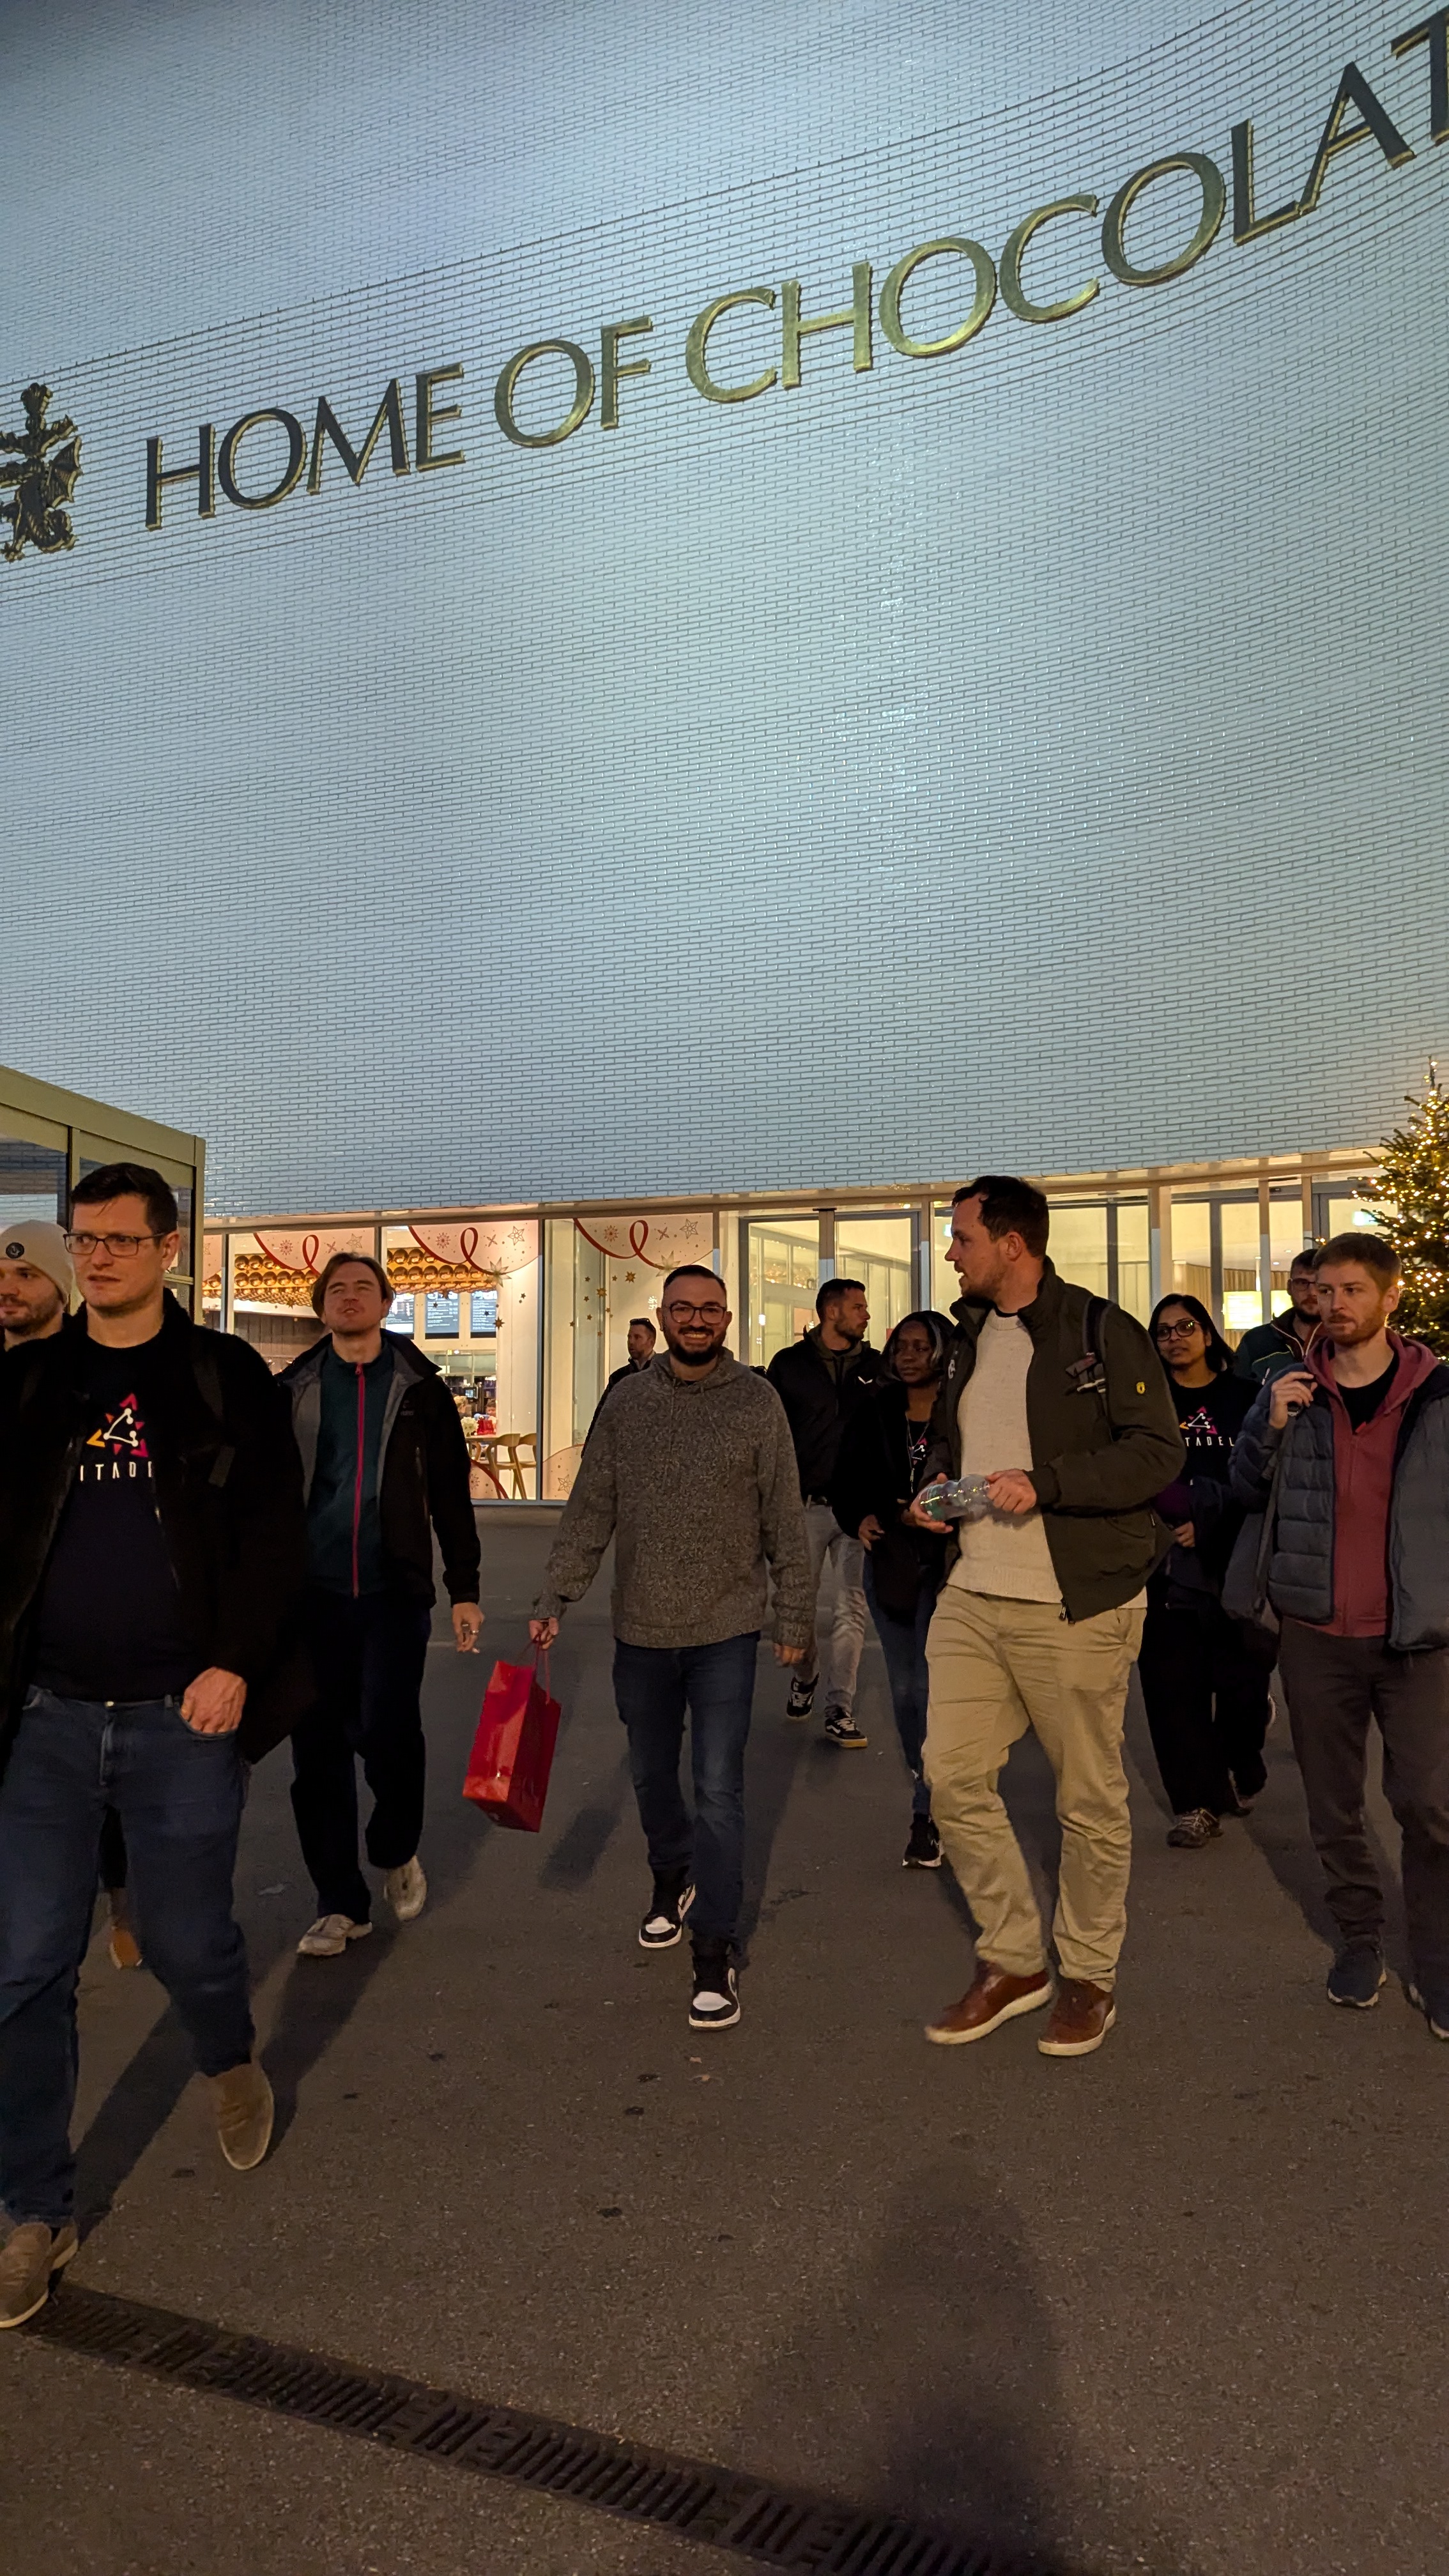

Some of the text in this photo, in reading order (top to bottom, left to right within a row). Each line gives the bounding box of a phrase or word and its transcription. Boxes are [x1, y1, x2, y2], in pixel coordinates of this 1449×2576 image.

[145, 8, 1449, 531] HOME OF CHOCOLAT
